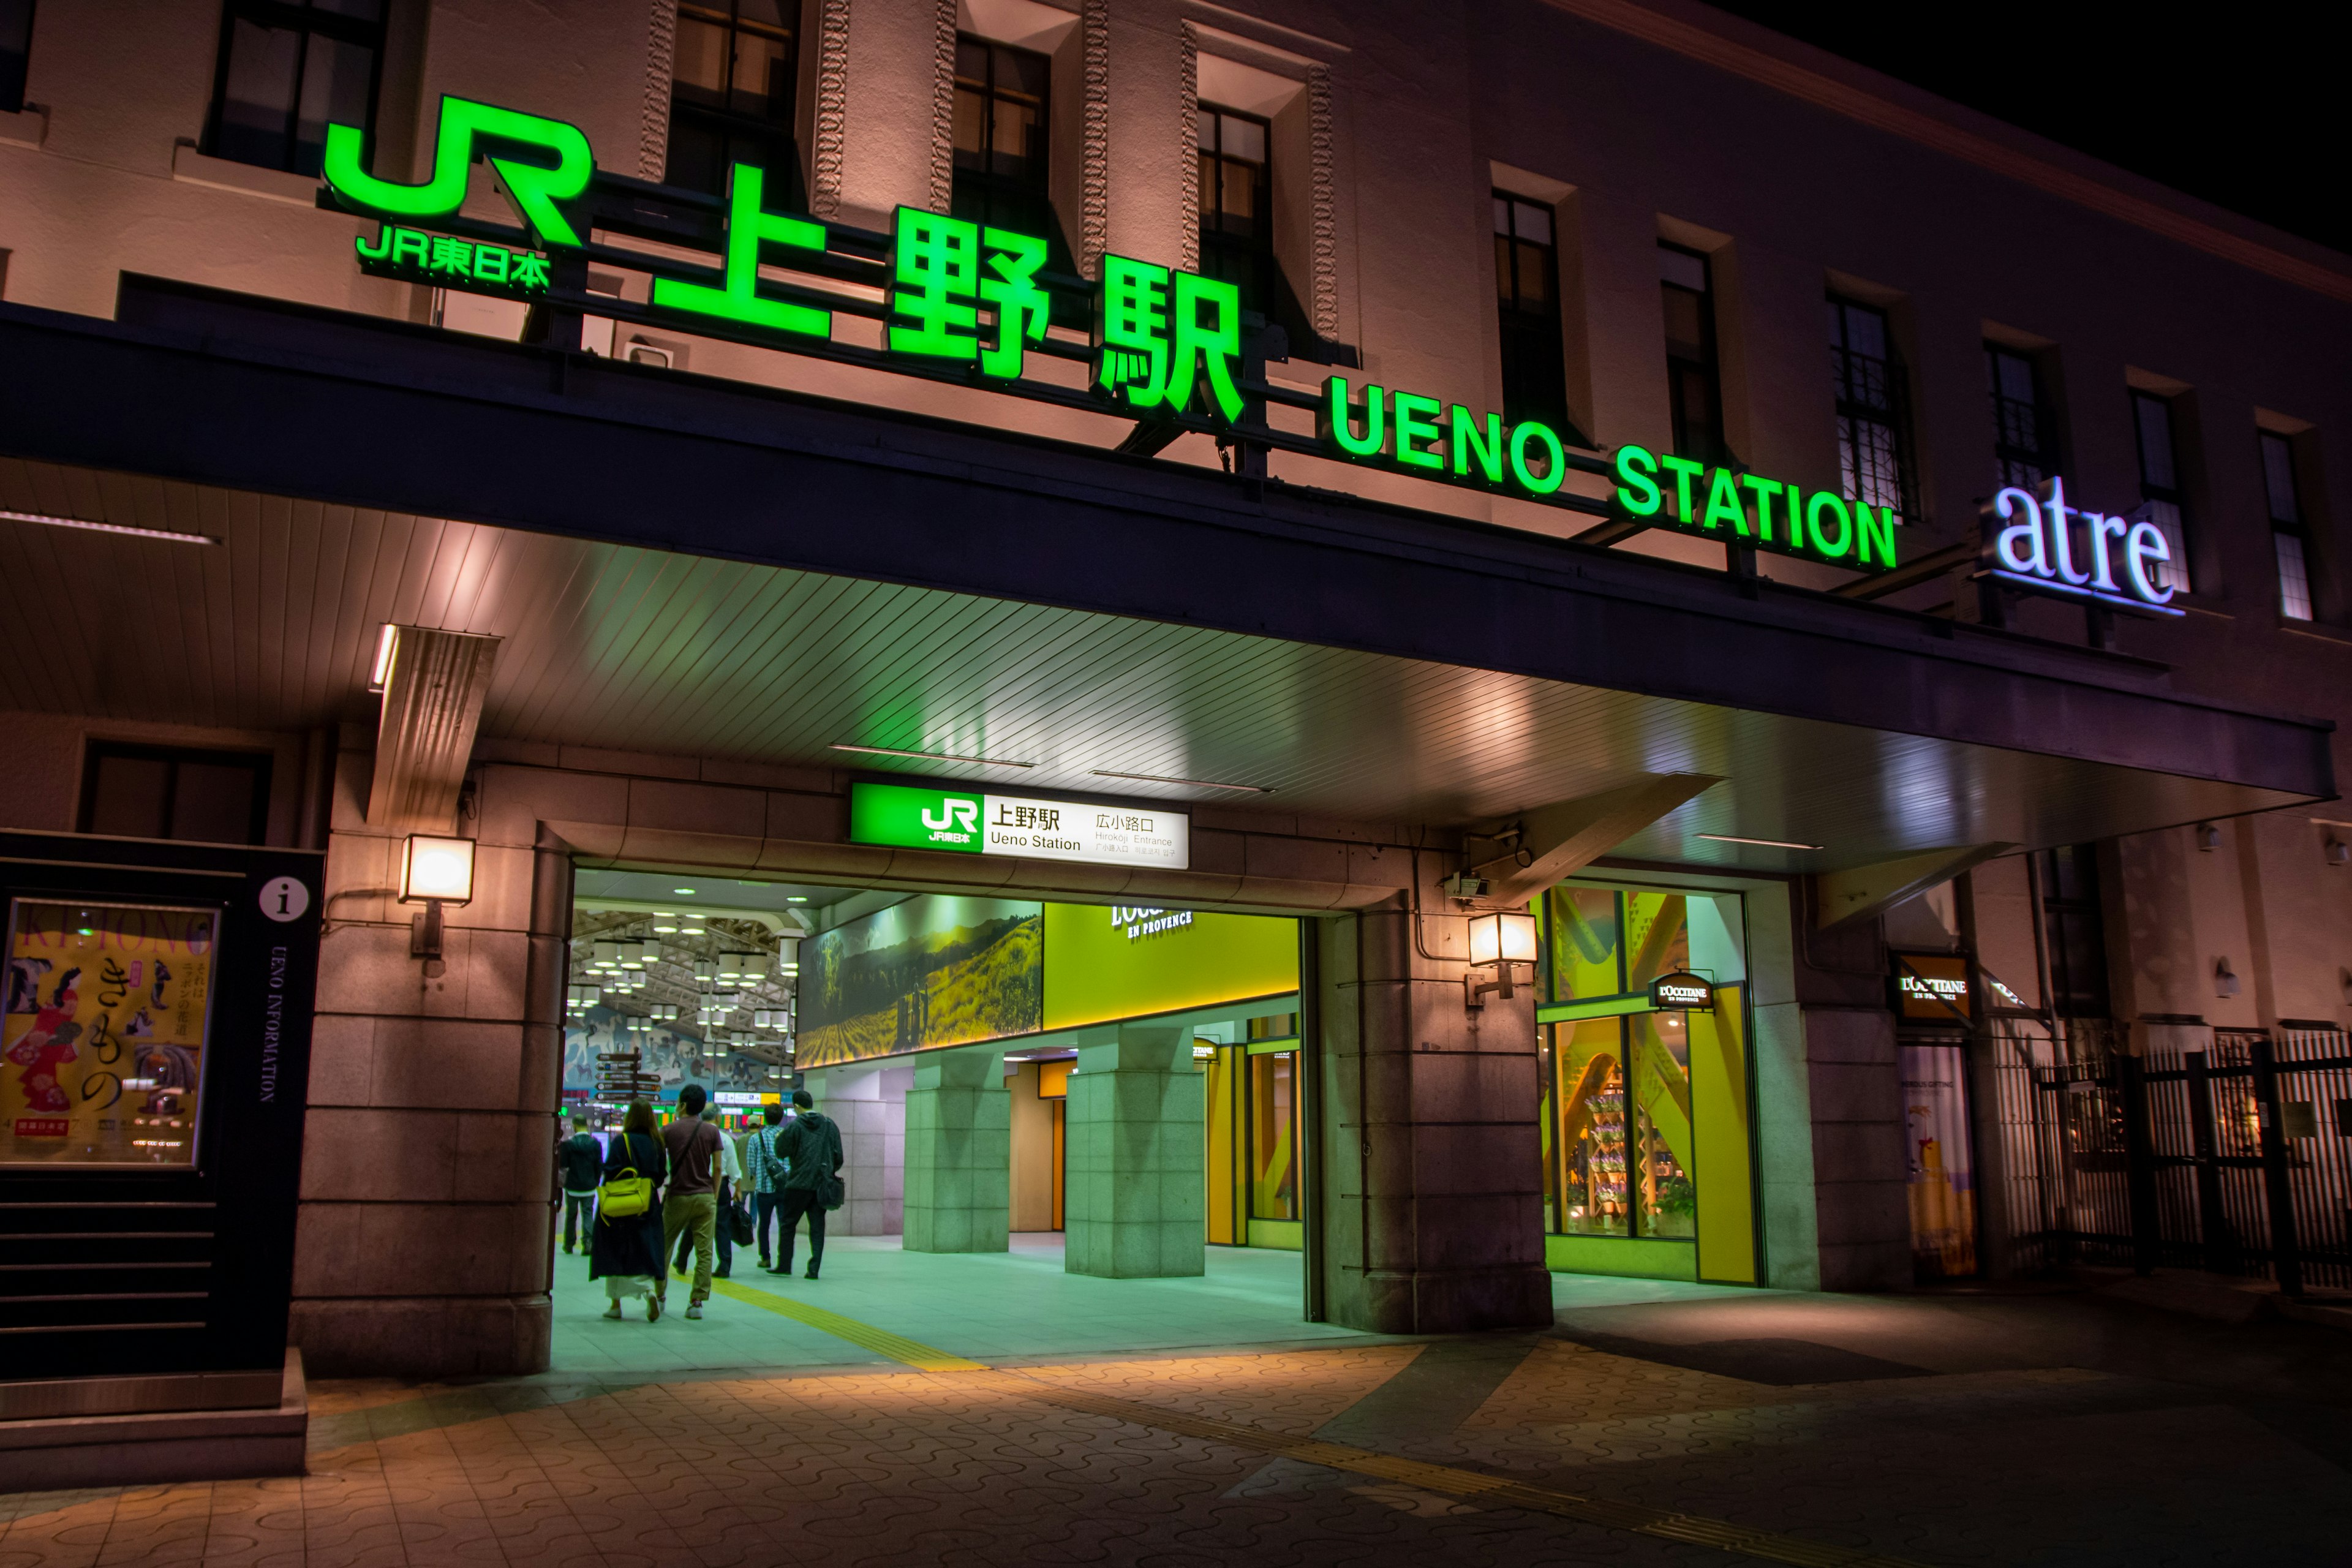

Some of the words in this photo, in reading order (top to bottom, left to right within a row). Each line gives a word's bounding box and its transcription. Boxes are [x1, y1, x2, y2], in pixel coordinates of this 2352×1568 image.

[323, 95, 593, 247] JR
[356, 225, 551, 290] JR東日本
[654, 162, 1245, 425] 上野駅
[1330, 375, 1566, 495] UENO
[1616, 444, 1896, 568] STATION
[1995, 475, 2174, 604] atre
[921, 798, 978, 833] JR
[992, 804, 1060, 832] 上野駅
[1096, 813, 1153, 833] 広小路口
[929, 831, 970, 843] JR東日本
[991, 831, 1027, 846] Ueno
[1032, 835, 1081, 851] Station
[1134, 835, 1172, 846] Entrance
[1128, 925, 1140, 938] EN
[1143, 911, 1192, 934] PROVENCE
[270, 946, 287, 989] UENO
[1659, 985, 1707, 998] L'OCCITANE
[82, 957, 130, 1111] きもの
[260, 993, 283, 1102] INFORMATION
